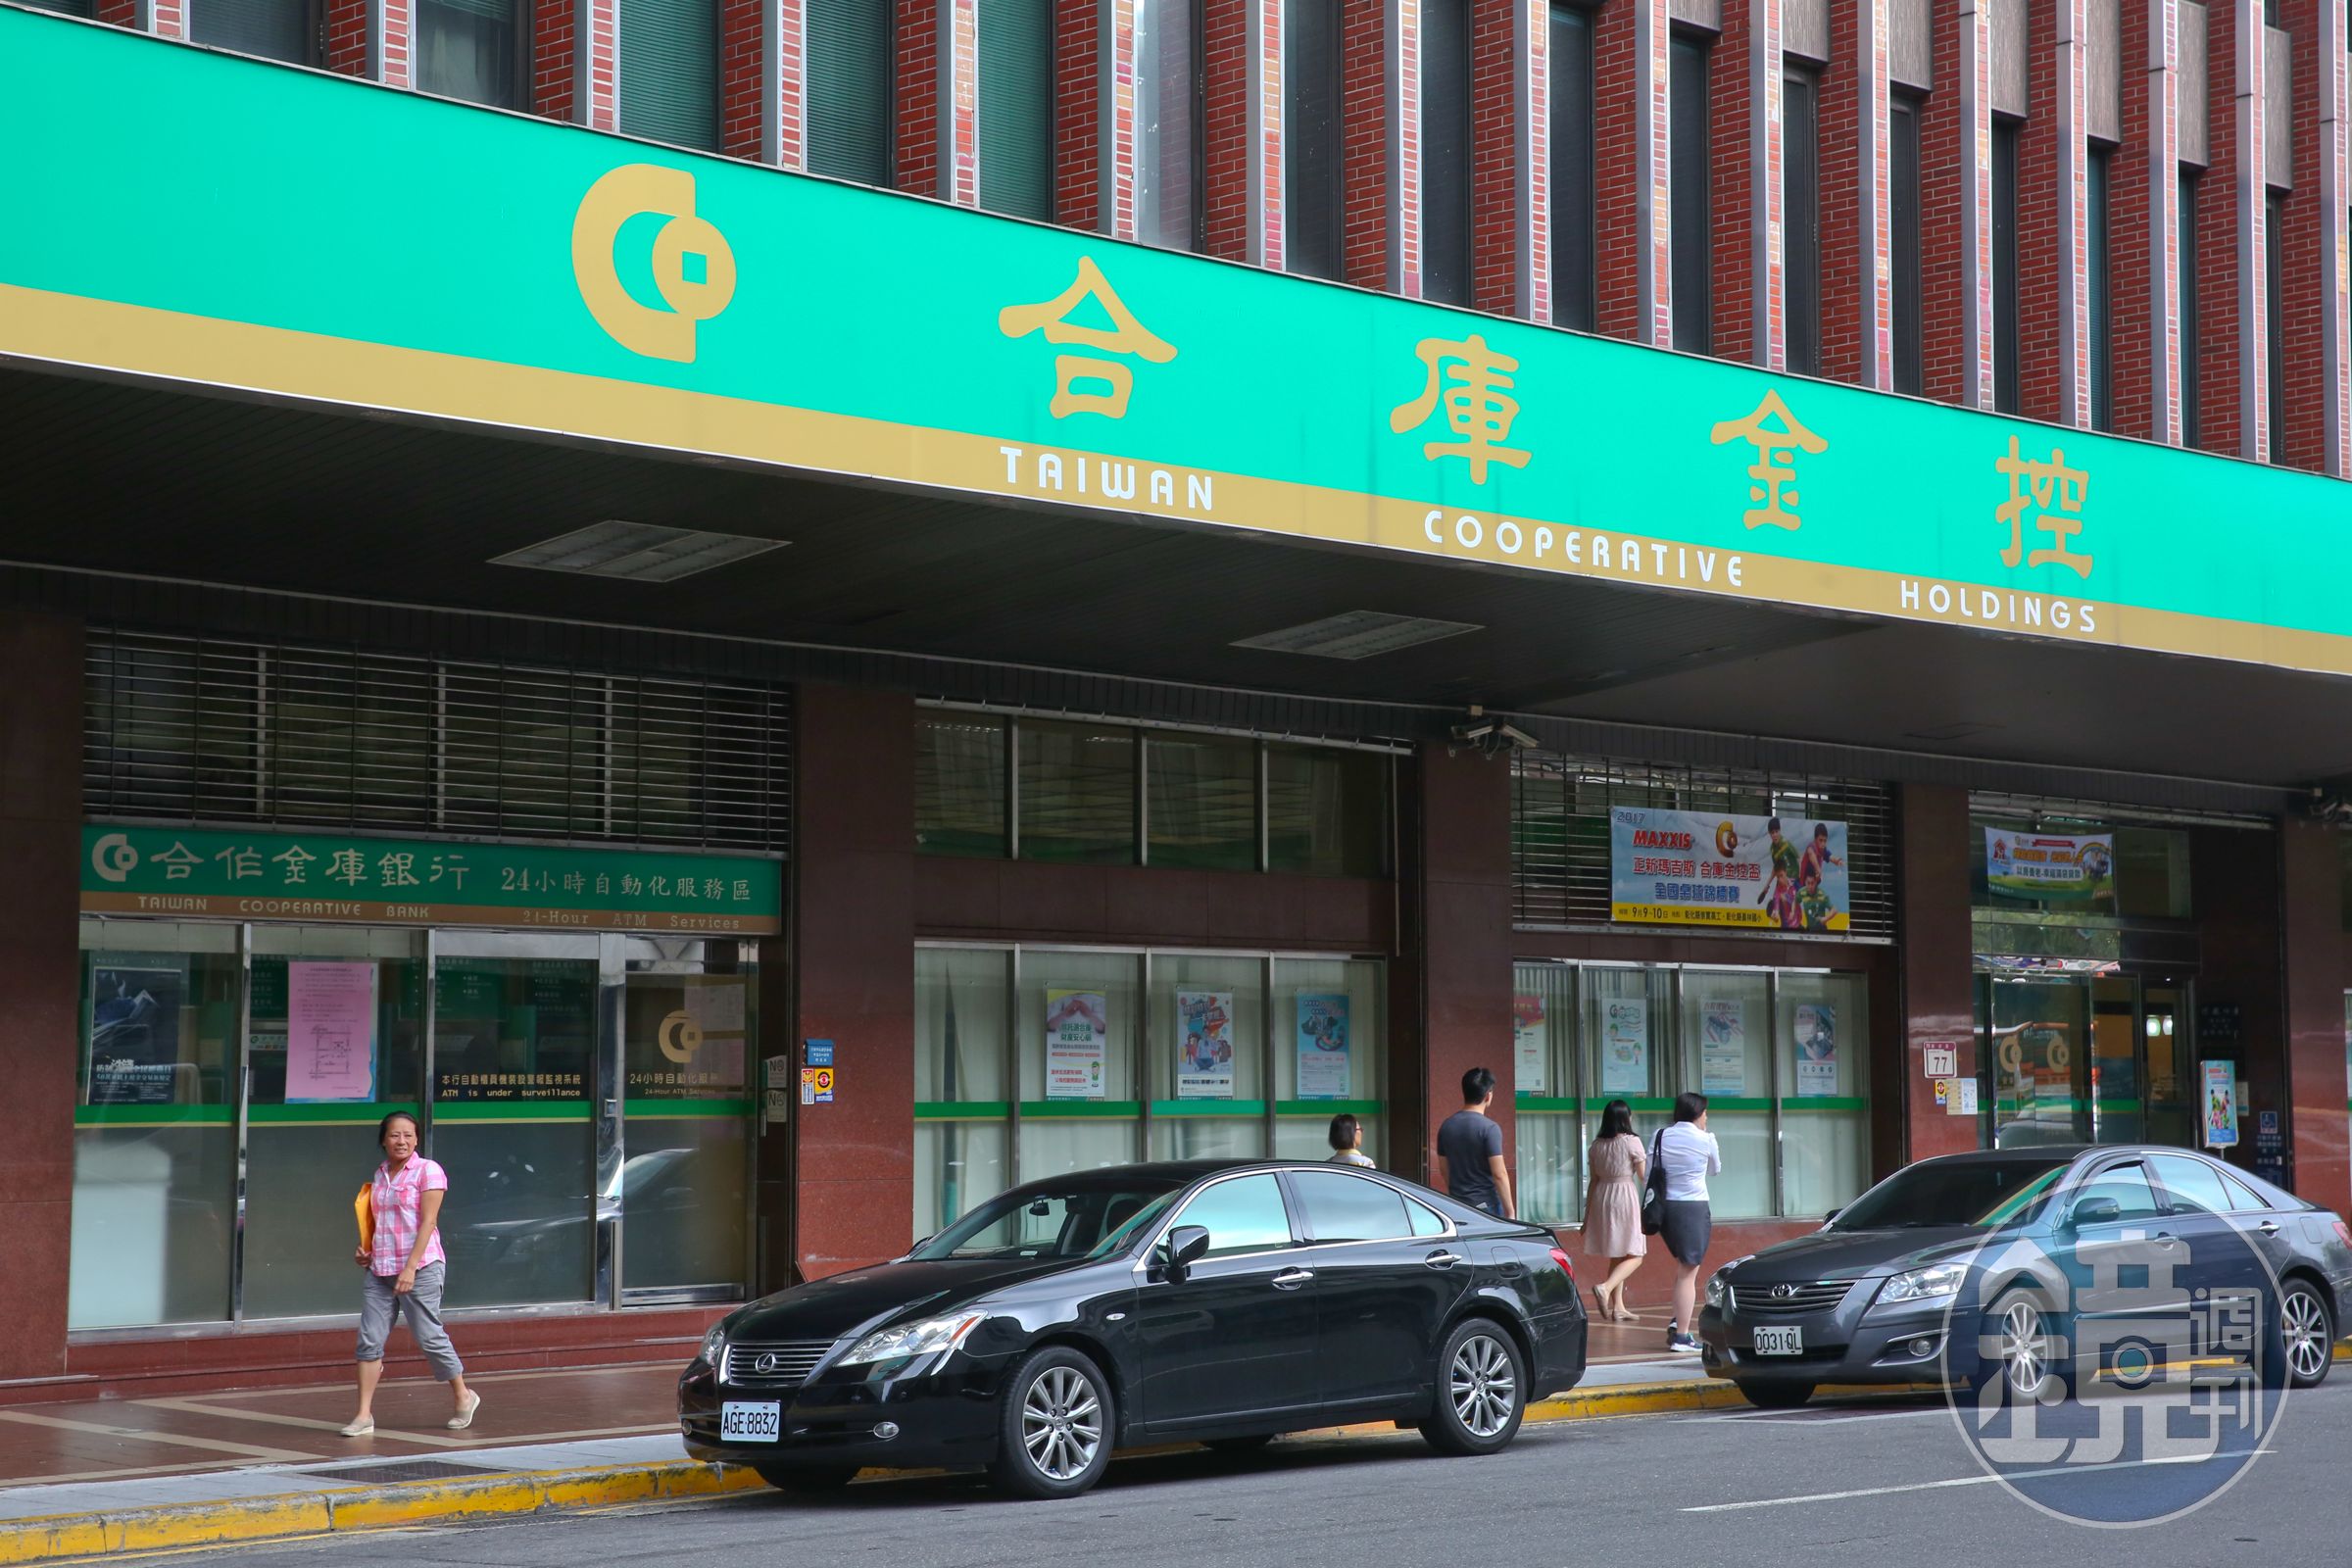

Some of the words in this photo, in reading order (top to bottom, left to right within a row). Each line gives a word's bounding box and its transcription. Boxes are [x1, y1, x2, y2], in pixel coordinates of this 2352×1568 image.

[1000, 446, 1212, 511] TAIWAN
[1424, 511, 1742, 587] COOPERATIVE
[1900, 580, 2096, 632] HOLDINGS
[1616, 811, 1646, 824] 2017
[1633, 830, 1692, 850] MAXXIS
[150, 841, 470, 891] 合作金庫銀行
[501, 867, 752, 901] 24小時自動化服務區
[1633, 856, 1695, 878] 正新瑪吉斯
[1700, 861, 1761, 881] 合庫金控盃
[138, 896, 208, 911] TAIWAN
[239, 899, 362, 916] COOPERATIVE
[386, 904, 429, 918] BANK
[612, 912, 647, 927] ATM
[670, 914, 740, 929] Services
[1934, 1055, 1947, 1073] 77
[442, 1089, 459, 1098] ATM
[468, 1089, 478, 1098] is
[487, 1089, 513, 1098] under
[521, 1089, 581, 1098] surveillance
